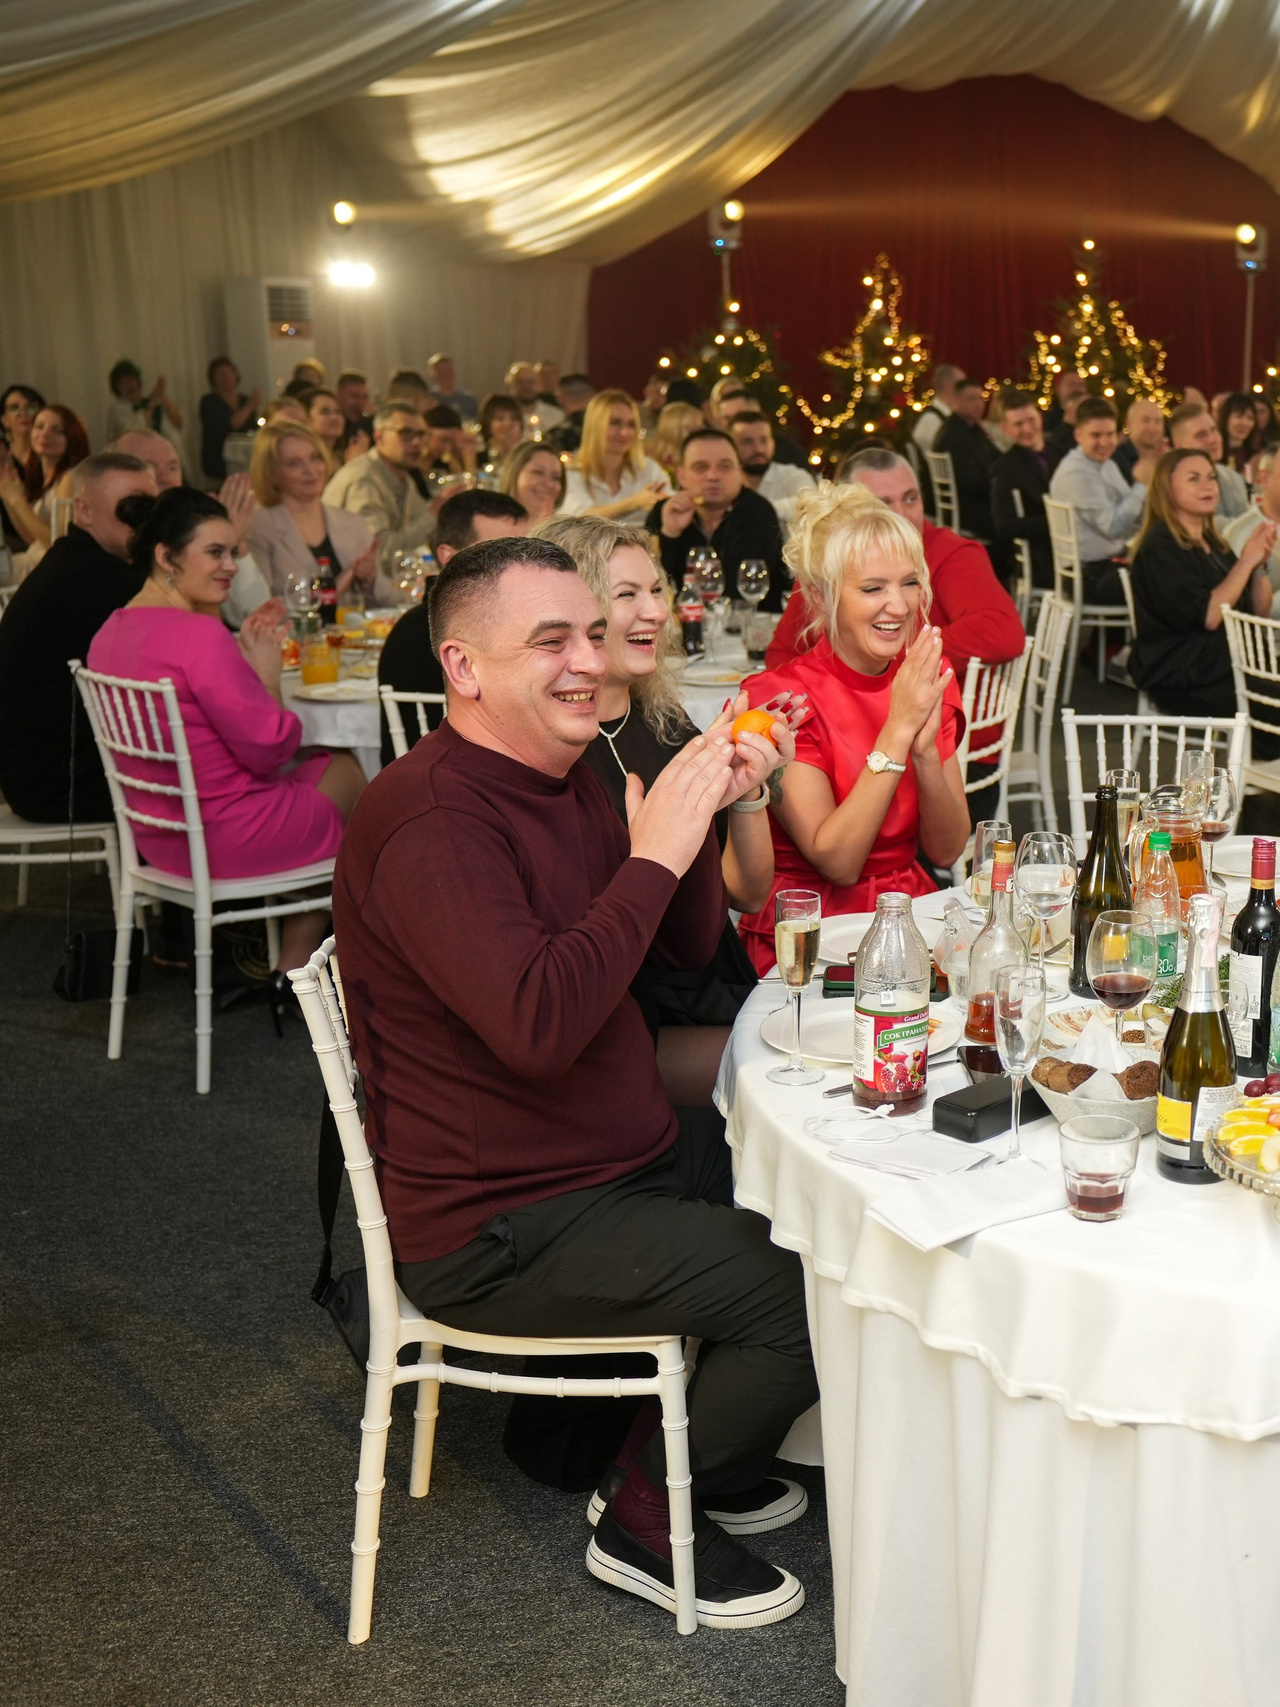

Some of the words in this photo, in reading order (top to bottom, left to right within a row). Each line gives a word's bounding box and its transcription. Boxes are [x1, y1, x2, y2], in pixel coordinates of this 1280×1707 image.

[904, 1014, 919, 1022] Grand
[884, 1032, 901, 1041] СОК
[902, 1025, 928, 1038] ГРАНАТО
